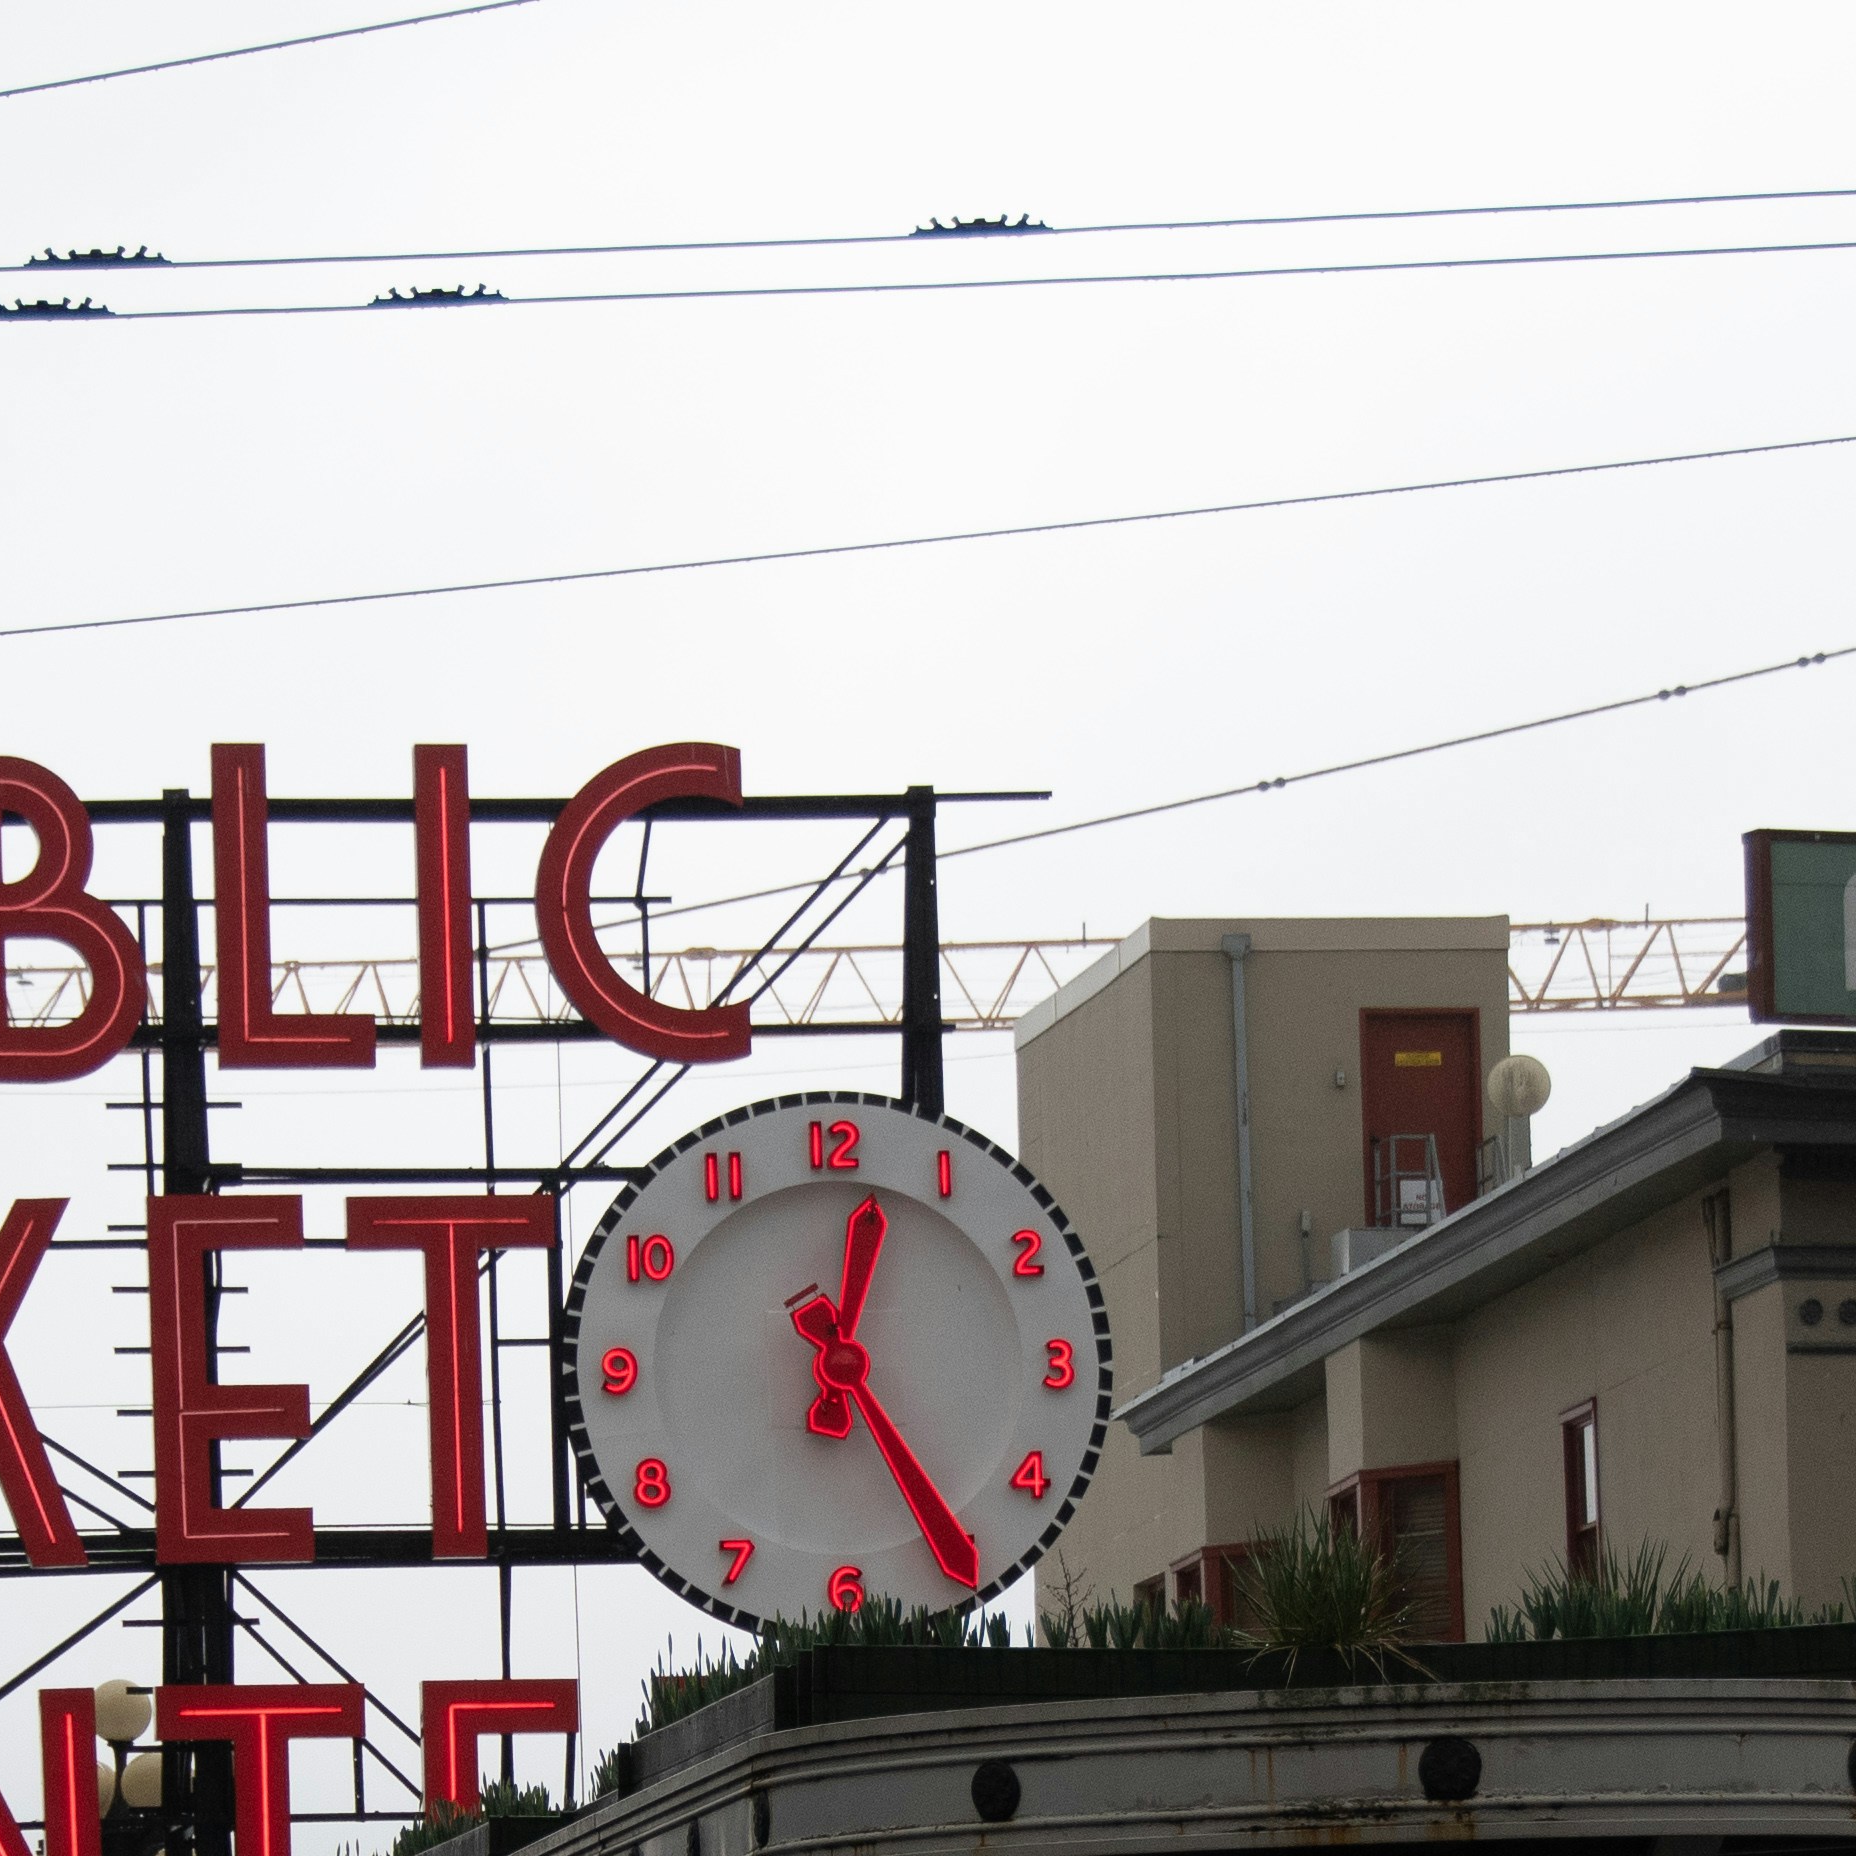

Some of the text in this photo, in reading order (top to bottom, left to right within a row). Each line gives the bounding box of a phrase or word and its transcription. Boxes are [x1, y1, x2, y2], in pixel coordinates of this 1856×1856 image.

[810, 1121, 859, 1170] 12
[705, 1152, 742, 1201] 11
[938, 1150, 951, 1198] 1
[627, 1235, 674, 1282] 10
[1012, 1230, 1044, 1277] 2
[601, 1348, 638, 1395] 9
[1043, 1338, 1074, 1389] 3
[634, 1458, 671, 1508] 8
[1011, 1450, 1051, 1499] 4
[719, 1539, 755, 1586] 7
[828, 1566, 864, 1613] 6
